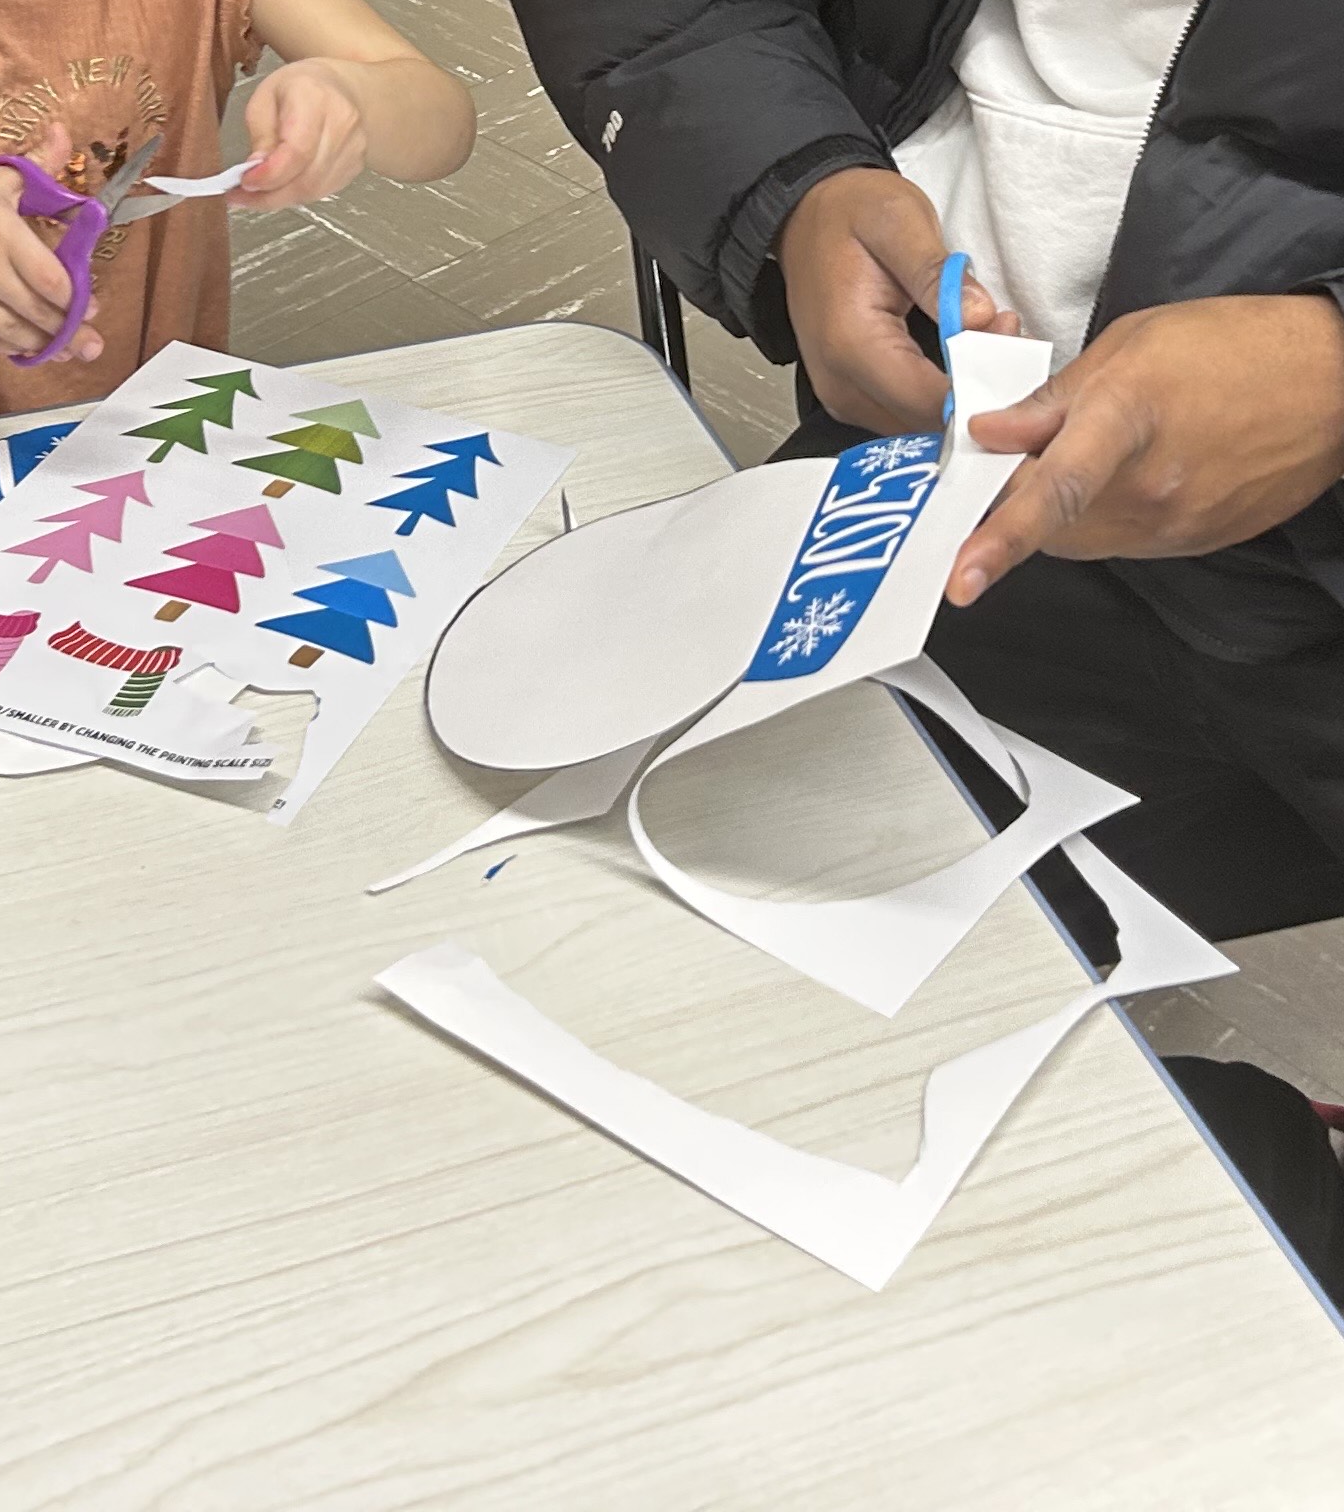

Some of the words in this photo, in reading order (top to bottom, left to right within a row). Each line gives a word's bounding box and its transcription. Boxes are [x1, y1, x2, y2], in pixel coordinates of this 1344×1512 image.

[787, 462, 942, 602] 2025
[58, 722, 78, 733] BY
[75, 726, 135, 750] CHANGING
[137, 743, 159, 757] THE
[158, 750, 214, 768] PRINTING
[212, 758, 250, 768] SCALE
